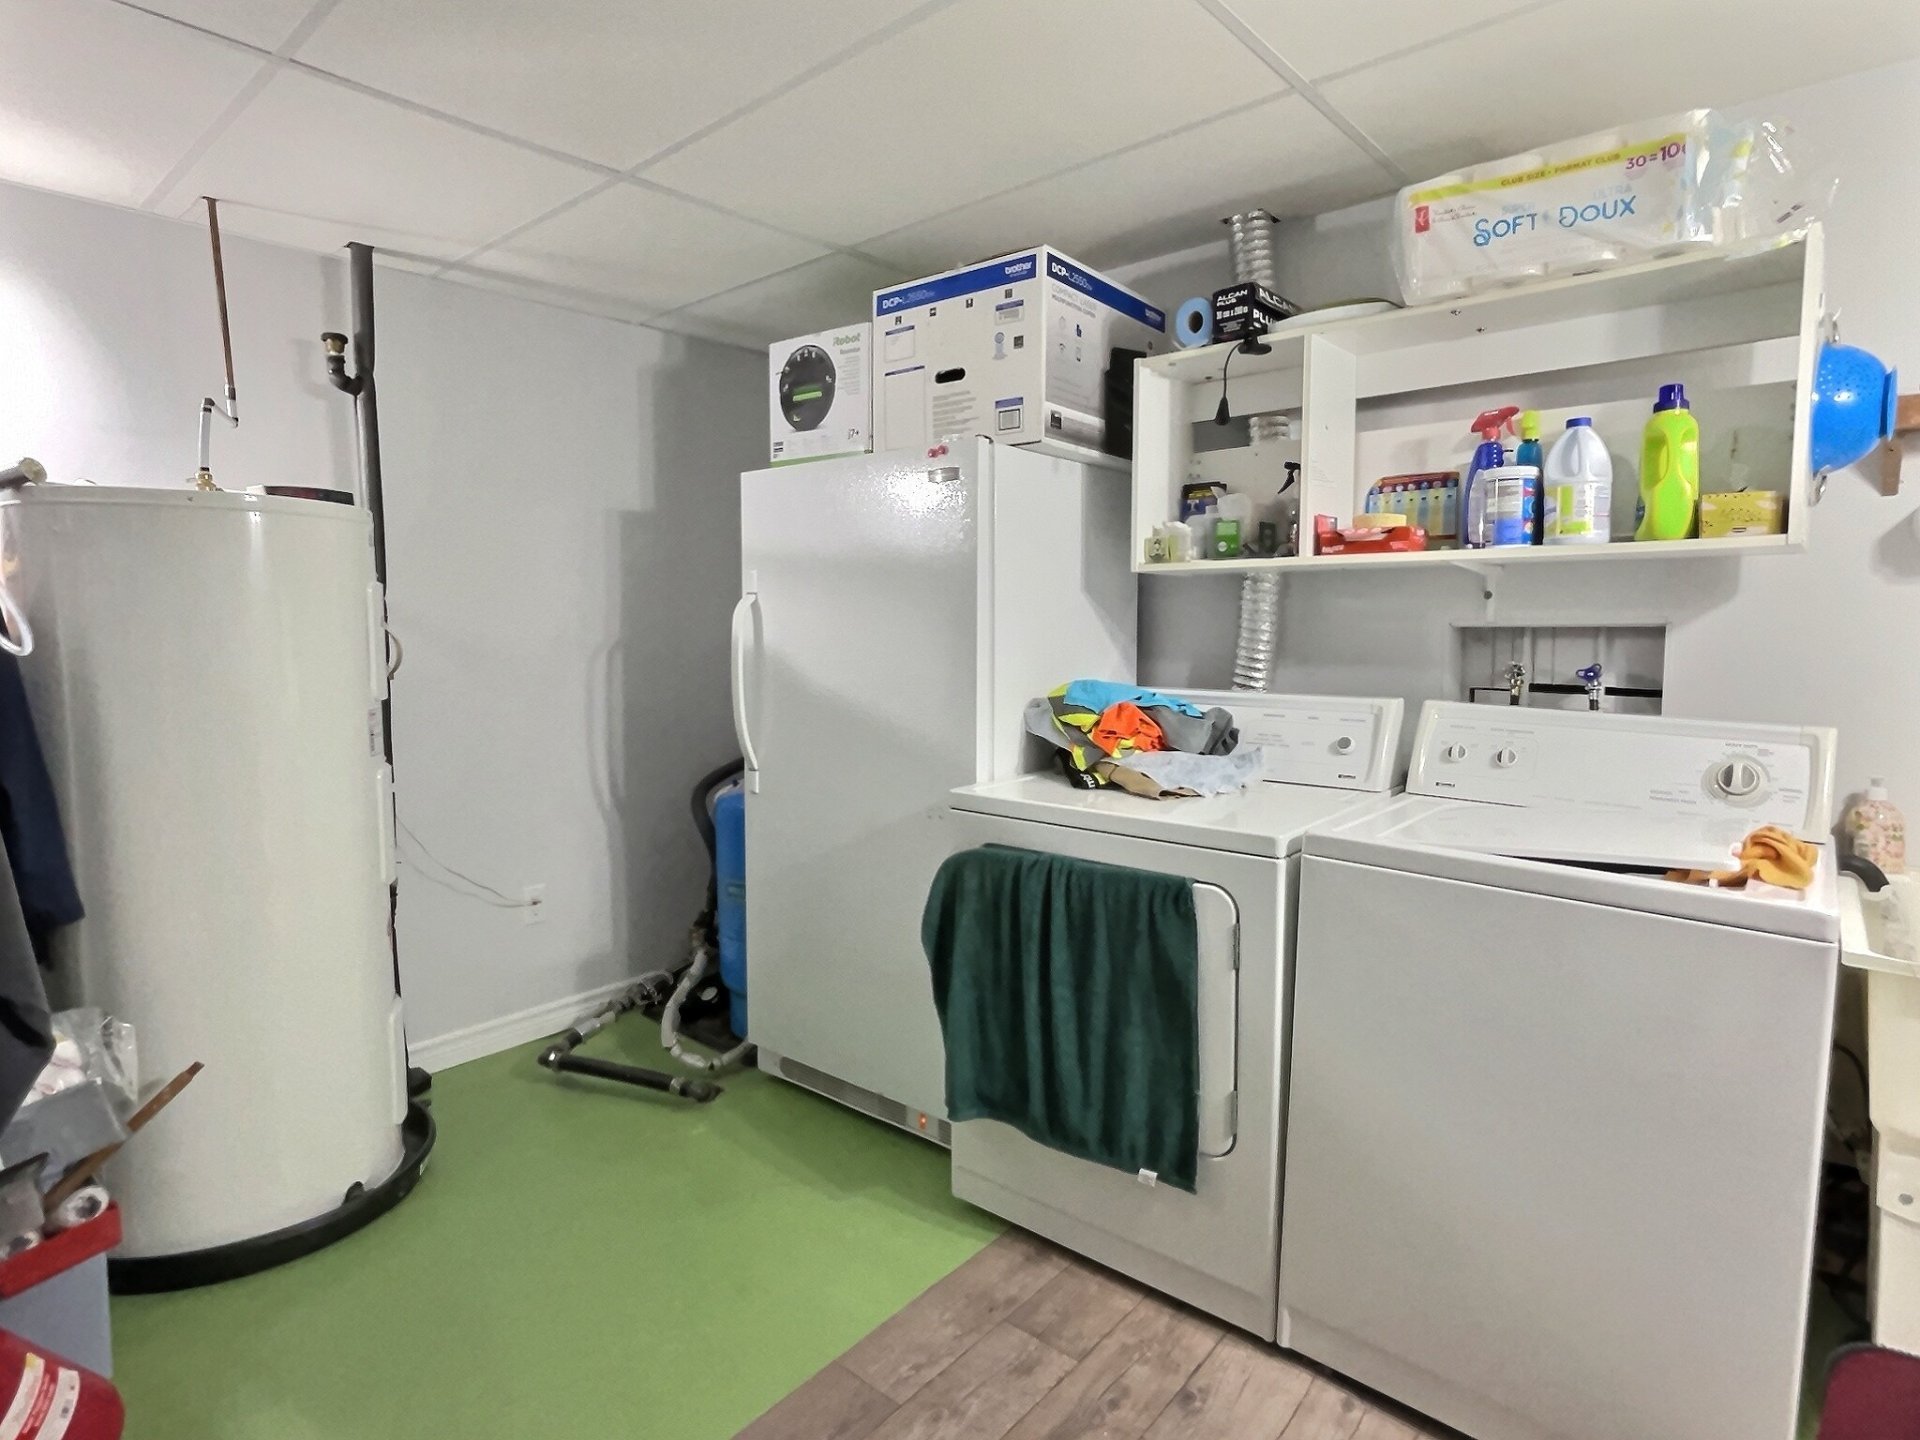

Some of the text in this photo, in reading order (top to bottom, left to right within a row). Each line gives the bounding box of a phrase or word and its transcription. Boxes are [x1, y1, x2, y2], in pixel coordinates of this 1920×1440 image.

[1500, 152, 1621, 187] CLUB SIZE FORMAT CLUB
[1473, 212, 1538, 247] SOFT
[1559, 195, 1636, 228] DOUX
[1005, 261, 1032, 275] brother
[1218, 289, 1248, 301] ALCAN
